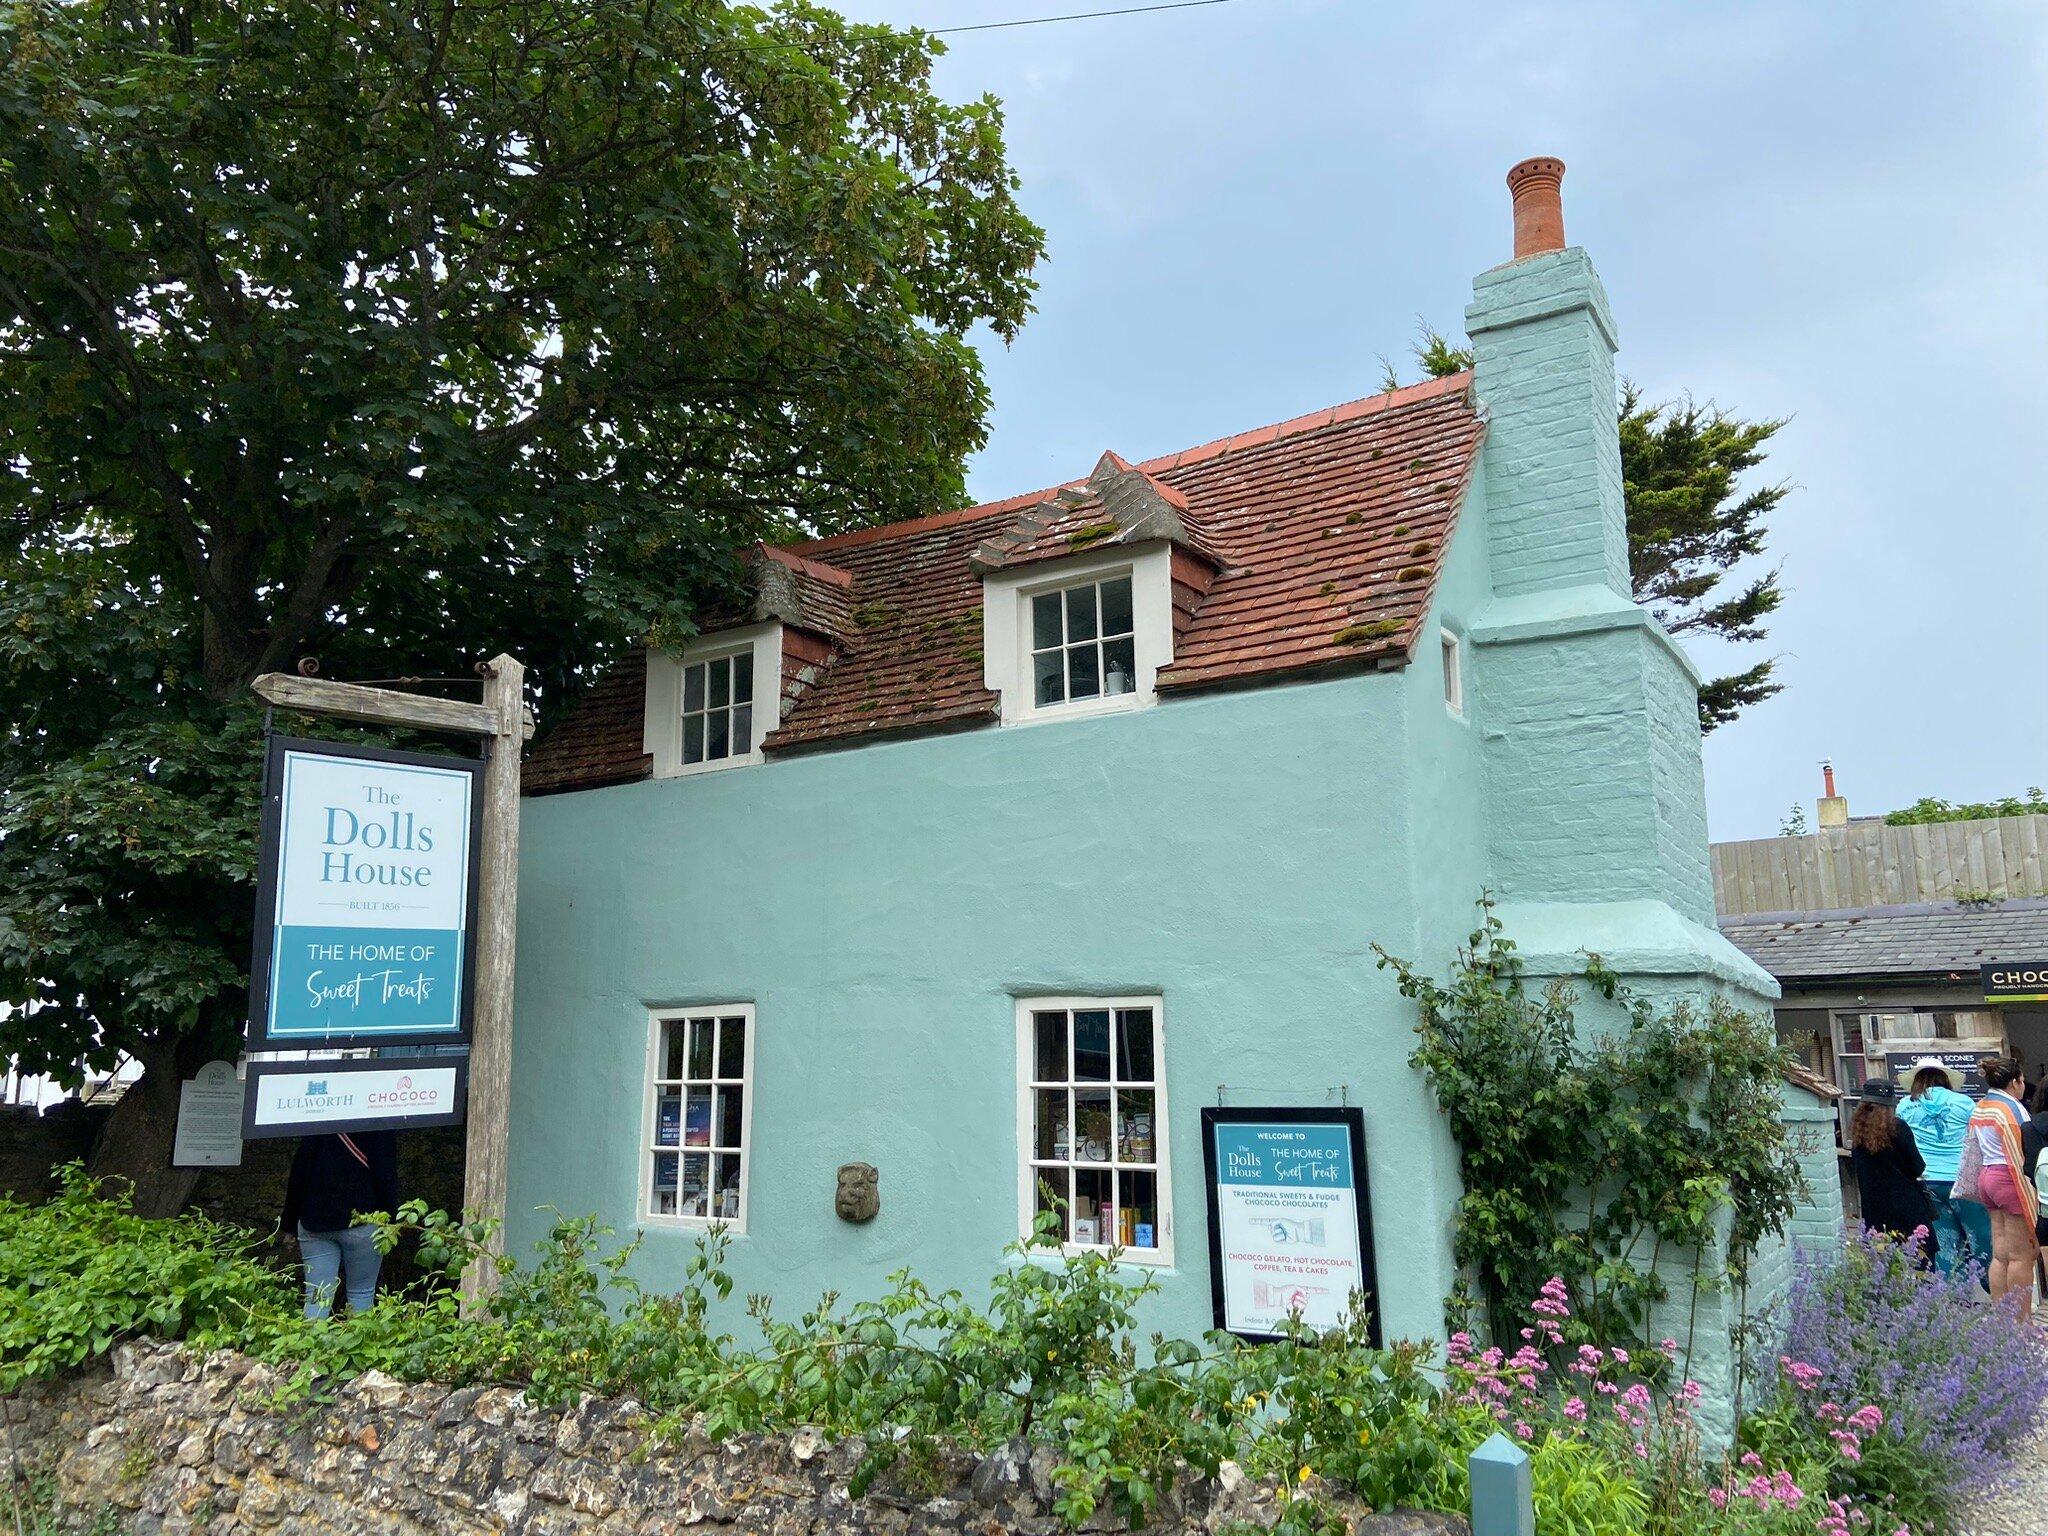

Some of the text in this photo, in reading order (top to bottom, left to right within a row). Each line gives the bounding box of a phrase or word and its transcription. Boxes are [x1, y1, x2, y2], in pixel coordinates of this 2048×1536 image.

[362, 785, 401, 805] The
[322, 806, 434, 852] Dolls
[320, 851, 432, 887] House
[349, 901, 377, 911] BUILT
[307, 944, 436, 961] THE HOME OF
[306, 969, 435, 1008] Sweet Treats
[1944, 1054, 1975, 1062] SCONES
[277, 1094, 353, 1110] LULWORTH
[368, 1090, 438, 1103] CHOCOCO
[1257, 1132, 1306, 1140] WELCOME TO
[1238, 1144, 1250, 1152] The
[1270, 1148, 1340, 1160] THE HOME OF
[1228, 1152, 1261, 1166] Dolls
[1229, 1165, 1262, 1178] House
[1274, 1161, 1340, 1182] Sweet Treats
[1232, 1190, 1278, 1199] TRADITIONAL
[1279, 1192, 1306, 1200] SWEETS
[1316, 1193, 1340, 1202] FUDGE
[1244, 1198, 1329, 1209] CHOCOCO CHOCOLATES
[1228, 1252, 1262, 1262] CHOCOCO
[1264, 1254, 1292, 1264] GELATO,
[1284, 1265, 1297, 1273] TEA
[1305, 1266, 1329, 1275] CAKES
